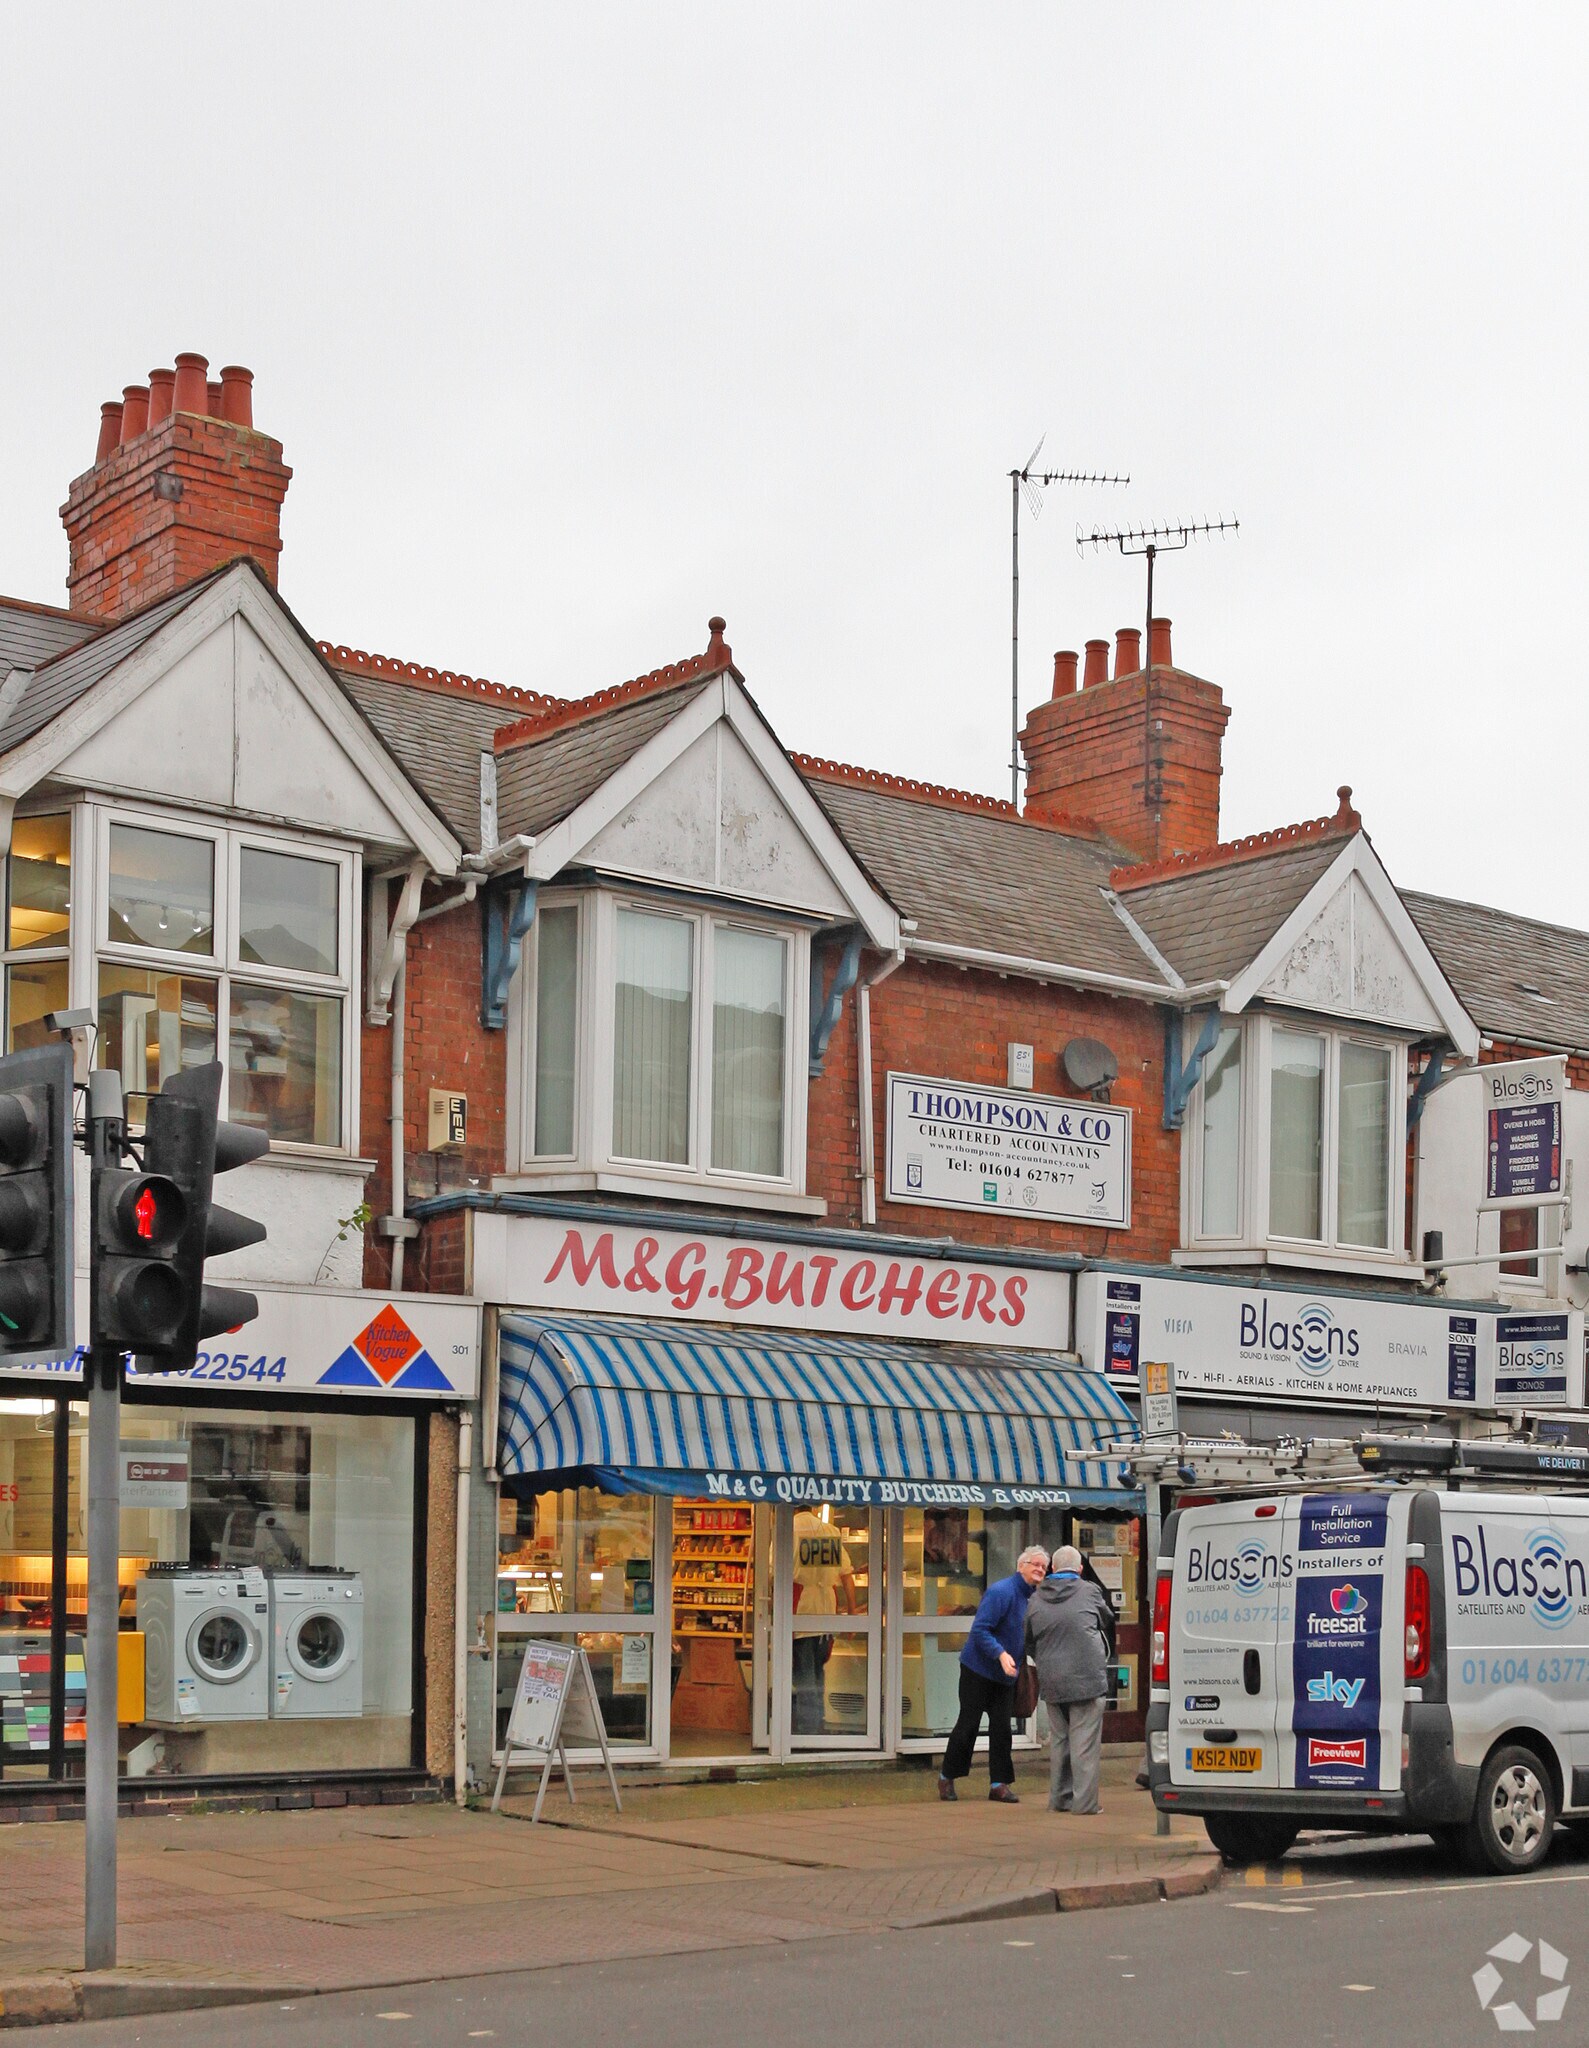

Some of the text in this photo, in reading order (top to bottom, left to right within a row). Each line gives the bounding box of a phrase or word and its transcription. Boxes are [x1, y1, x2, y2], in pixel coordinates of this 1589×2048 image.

[1493, 1075, 1553, 1098] Blasons
[450, 1099, 465, 1141] EMS
[908, 1090, 1111, 1141] THOMPSON & CO
[1504, 1121, 1523, 1129] OVENS
[919, 1124, 1100, 1160] CHARTERED ACCOUNTANTS
[1511, 1134, 1538, 1142] WASHING
[1510, 1142, 1539, 1151] MACHINES
[1509, 1156, 1533, 1165] FRIDGES
[946, 1157, 1075, 1185] Tel: 01604 627877
[1510, 1163, 1539, 1173] FREEZERS
[1512, 1178, 1535, 1186] TUMBLE
[1512, 1186, 1535, 1194] DRYERS
[1106, 1302, 1133, 1310] Installers
[366, 1323, 411, 1342] Kitchen
[1240, 1298, 1360, 1357] Blasons
[1505, 1325, 1560, 1333] www.blasons.co.uk
[1449, 1334, 1476, 1344] SONY
[366, 1341, 408, 1363] Vogue
[452, 1345, 469, 1355] 301
[1113, 1340, 1132, 1355] sky
[1388, 1342, 1428, 1356] BRAVIA
[1240, 1350, 1291, 1362] SOUND & VISION
[1500, 1343, 1564, 1367] Blasons
[1338, 1359, 1359, 1368] CENTRE
[1178, 1370, 1190, 1381] TV
[1204, 1372, 1225, 1384] HI-FI
[1236, 1375, 1275, 1387] AERIALS
[1286, 1378, 1325, 1391] KITCHEN
[1328, 1382, 1333, 1391] &
[1336, 1383, 1363, 1394] HOME
[1366, 1385, 1418, 1397] APPLIANCES
[1517, 1381, 1545, 1390] SONOS
[1538, 1457, 1551, 1468] WE
[1552, 1458, 1580, 1469] DELIVER
[776, 1476, 872, 1502] QUALITY
[879, 1481, 986, 1504] BUTCHERS
[1011, 1488, 1071, 1504] 604127
[1331, 1504, 1352, 1517] Full
[1311, 1518, 1372, 1532] Installation
[1320, 1532, 1361, 1545] Service
[800, 1538, 841, 1566] OPEN
[1188, 1541, 1293, 1583] Blasons
[1298, 1555, 1384, 1570] Installers of
[1452, 1525, 1588, 1598] Blason
[1187, 1584, 1230, 1594] SATELLITES AND
[1268, 1580, 1292, 1589] AERIALS
[1186, 1606, 1290, 1625] 01604 637722
[1458, 1604, 1526, 1616] SATELLITES AND
[1307, 1612, 1367, 1634] freesat
[1306, 1640, 1365, 1649] brilliant for everyone
[1462, 1658, 1588, 1684] 01604 6377
[546, 1686, 558, 1694] OX
[1306, 1671, 1366, 1708] sky
[1197, 1750, 1256, 1766] KS12 NDV
[1314, 1746, 1360, 1758] Freeview
